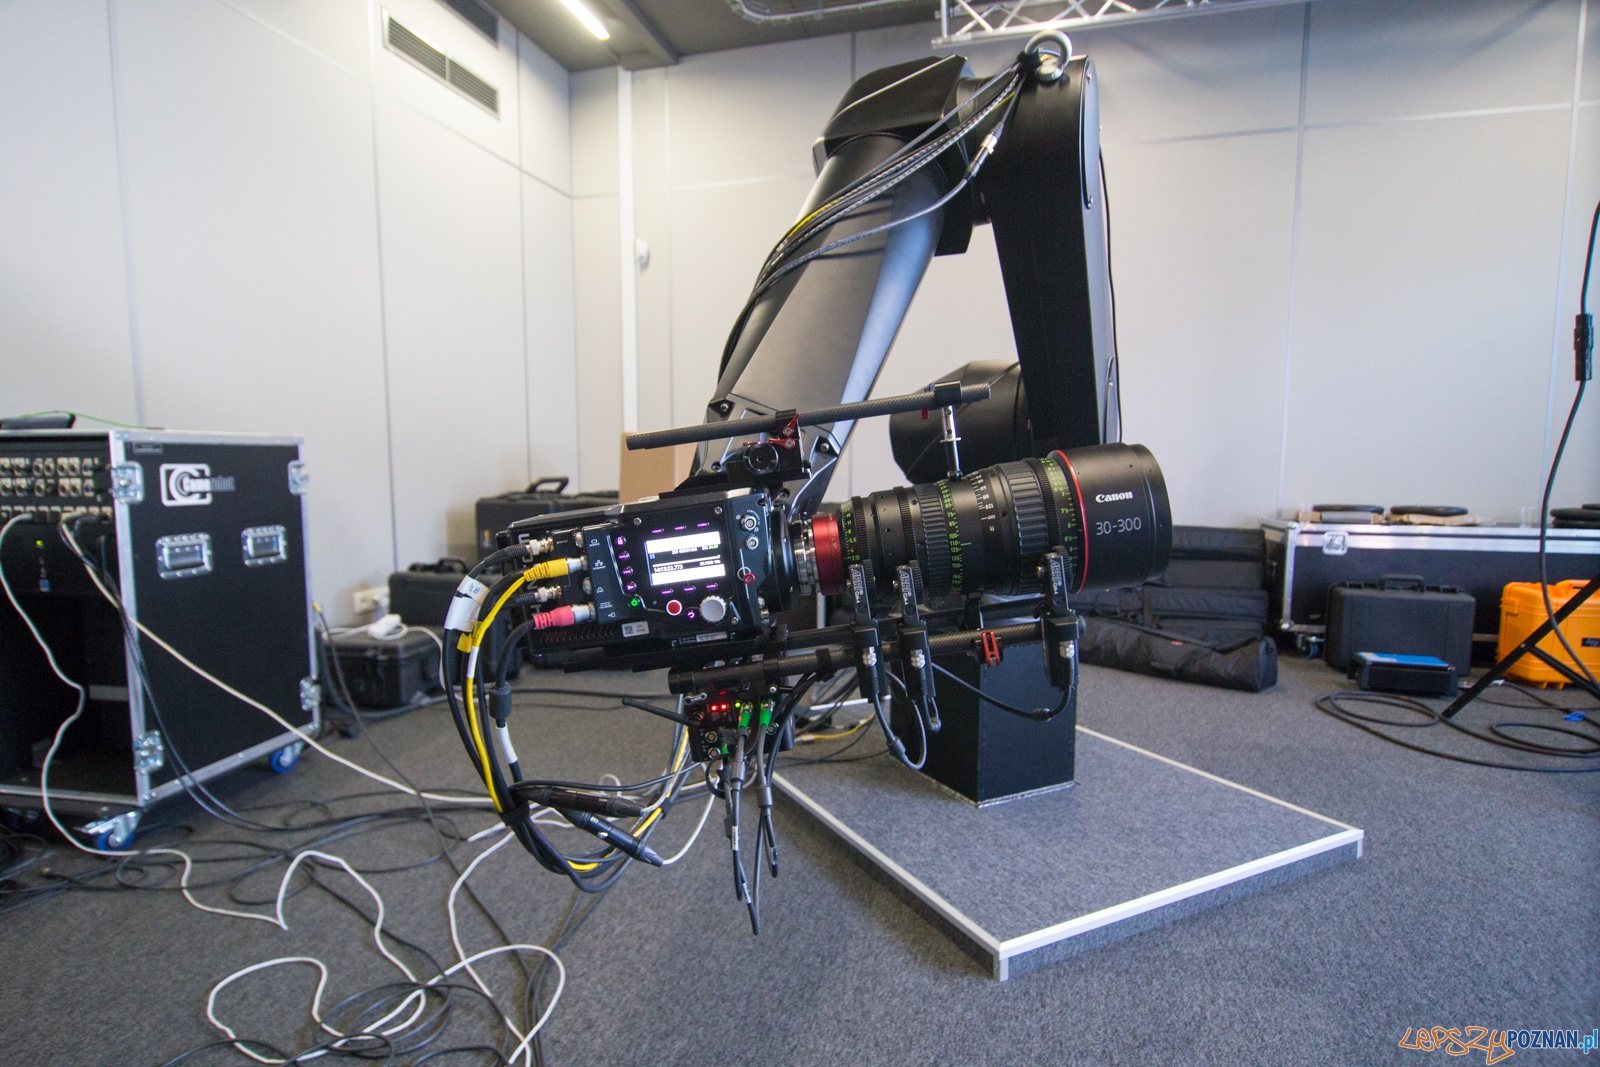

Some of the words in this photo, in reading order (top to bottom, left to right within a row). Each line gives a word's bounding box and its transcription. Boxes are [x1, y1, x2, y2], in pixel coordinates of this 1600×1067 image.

[1095, 491, 1133, 503] Canon
[1096, 516, 1142, 535] 30-300
[850, 568, 863, 591] ARRI
[899, 569, 912, 593] ARRI
[1050, 558, 1062, 582] ARRI
